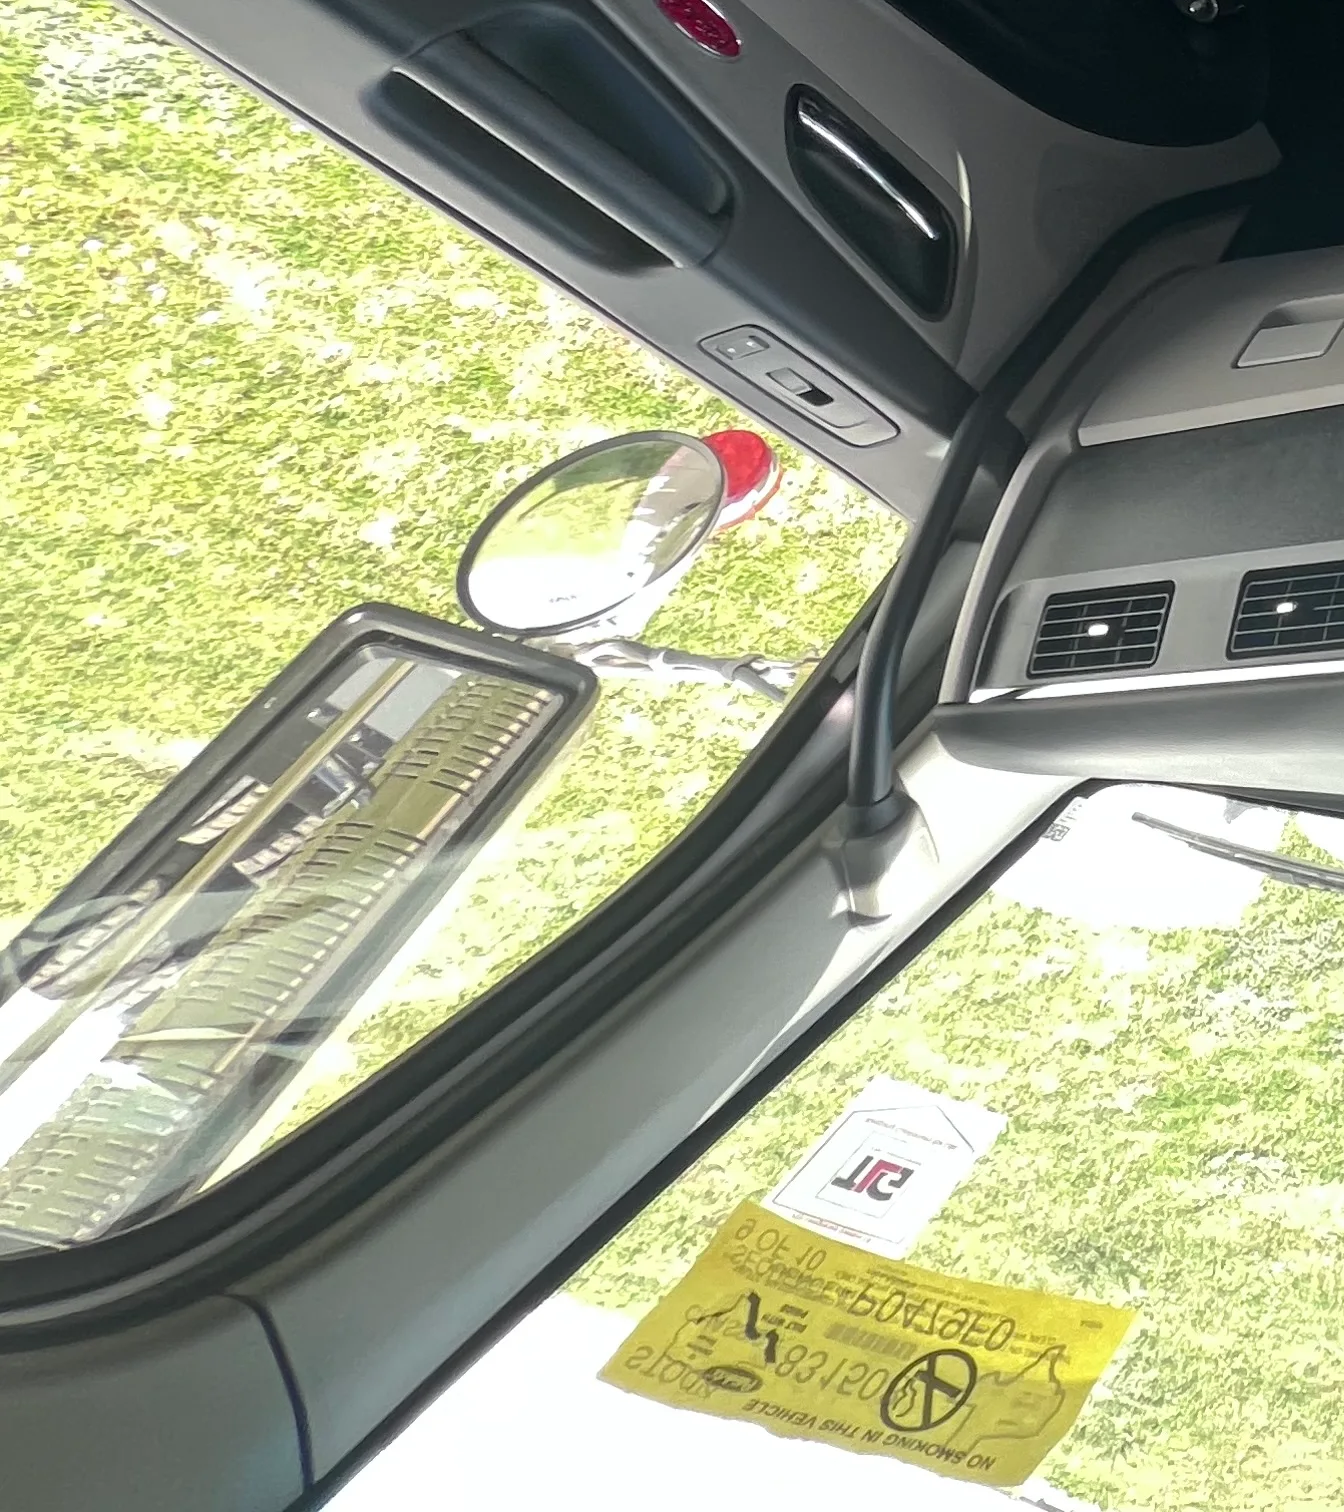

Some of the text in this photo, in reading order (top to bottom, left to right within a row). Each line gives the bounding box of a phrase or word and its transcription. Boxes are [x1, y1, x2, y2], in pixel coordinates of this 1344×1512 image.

[742, 1399, 996, 1471] NO SMOKING IN THIS VEHICLE
